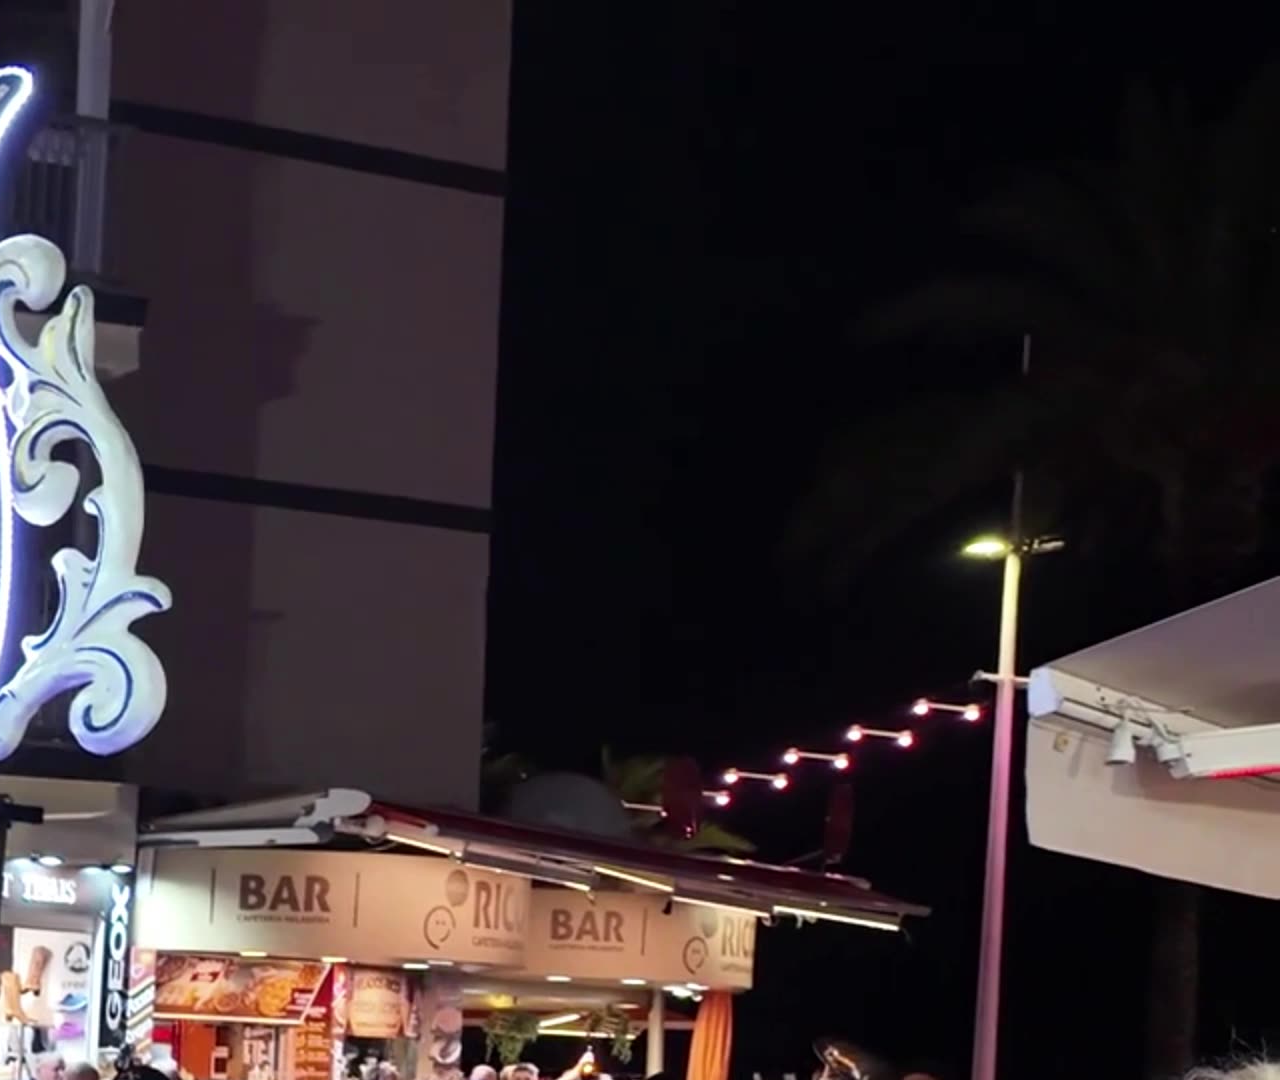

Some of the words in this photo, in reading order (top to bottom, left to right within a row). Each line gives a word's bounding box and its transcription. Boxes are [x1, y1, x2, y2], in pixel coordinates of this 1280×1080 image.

[238, 872, 332, 913] BAR
[550, 907, 625, 943] BAR
[105, 882, 131, 1032] GEOX
